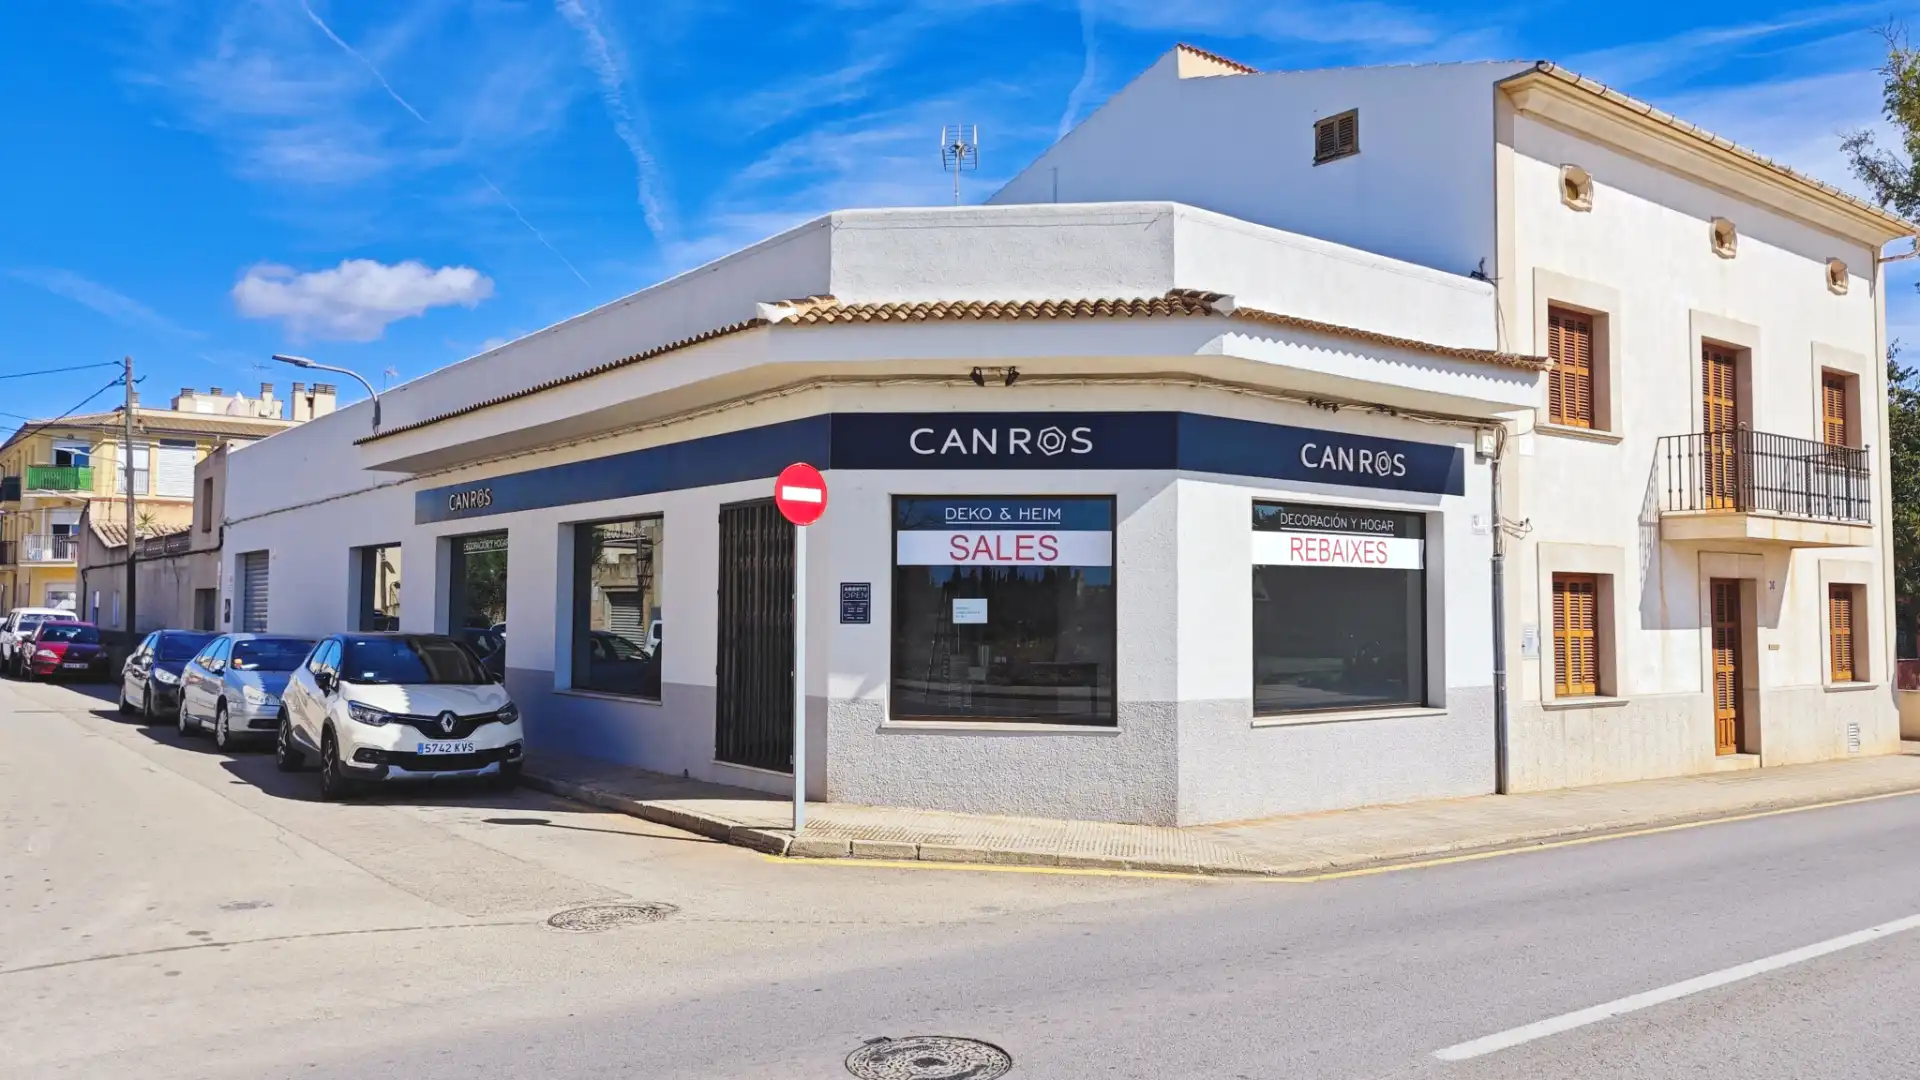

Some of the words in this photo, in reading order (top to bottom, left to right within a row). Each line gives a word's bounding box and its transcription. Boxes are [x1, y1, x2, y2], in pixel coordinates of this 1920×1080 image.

[909, 426, 1093, 456] CANROS
[1300, 443, 1406, 477] CANROS
[449, 488, 491, 511] CANROS
[945, 507, 992, 520] DEKO
[999, 507, 1012, 520] &
[1019, 507, 1061, 520] HEIM
[1280, 512, 1348, 528] DECORACIÓN
[1350, 518, 1358, 530] Y
[1360, 519, 1394, 532] HOGAR
[949, 534, 1059, 561] SALES
[1290, 537, 1388, 564] REBAIXES
[425, 743, 452, 753] 5742
[454, 742, 474, 752] KVS
